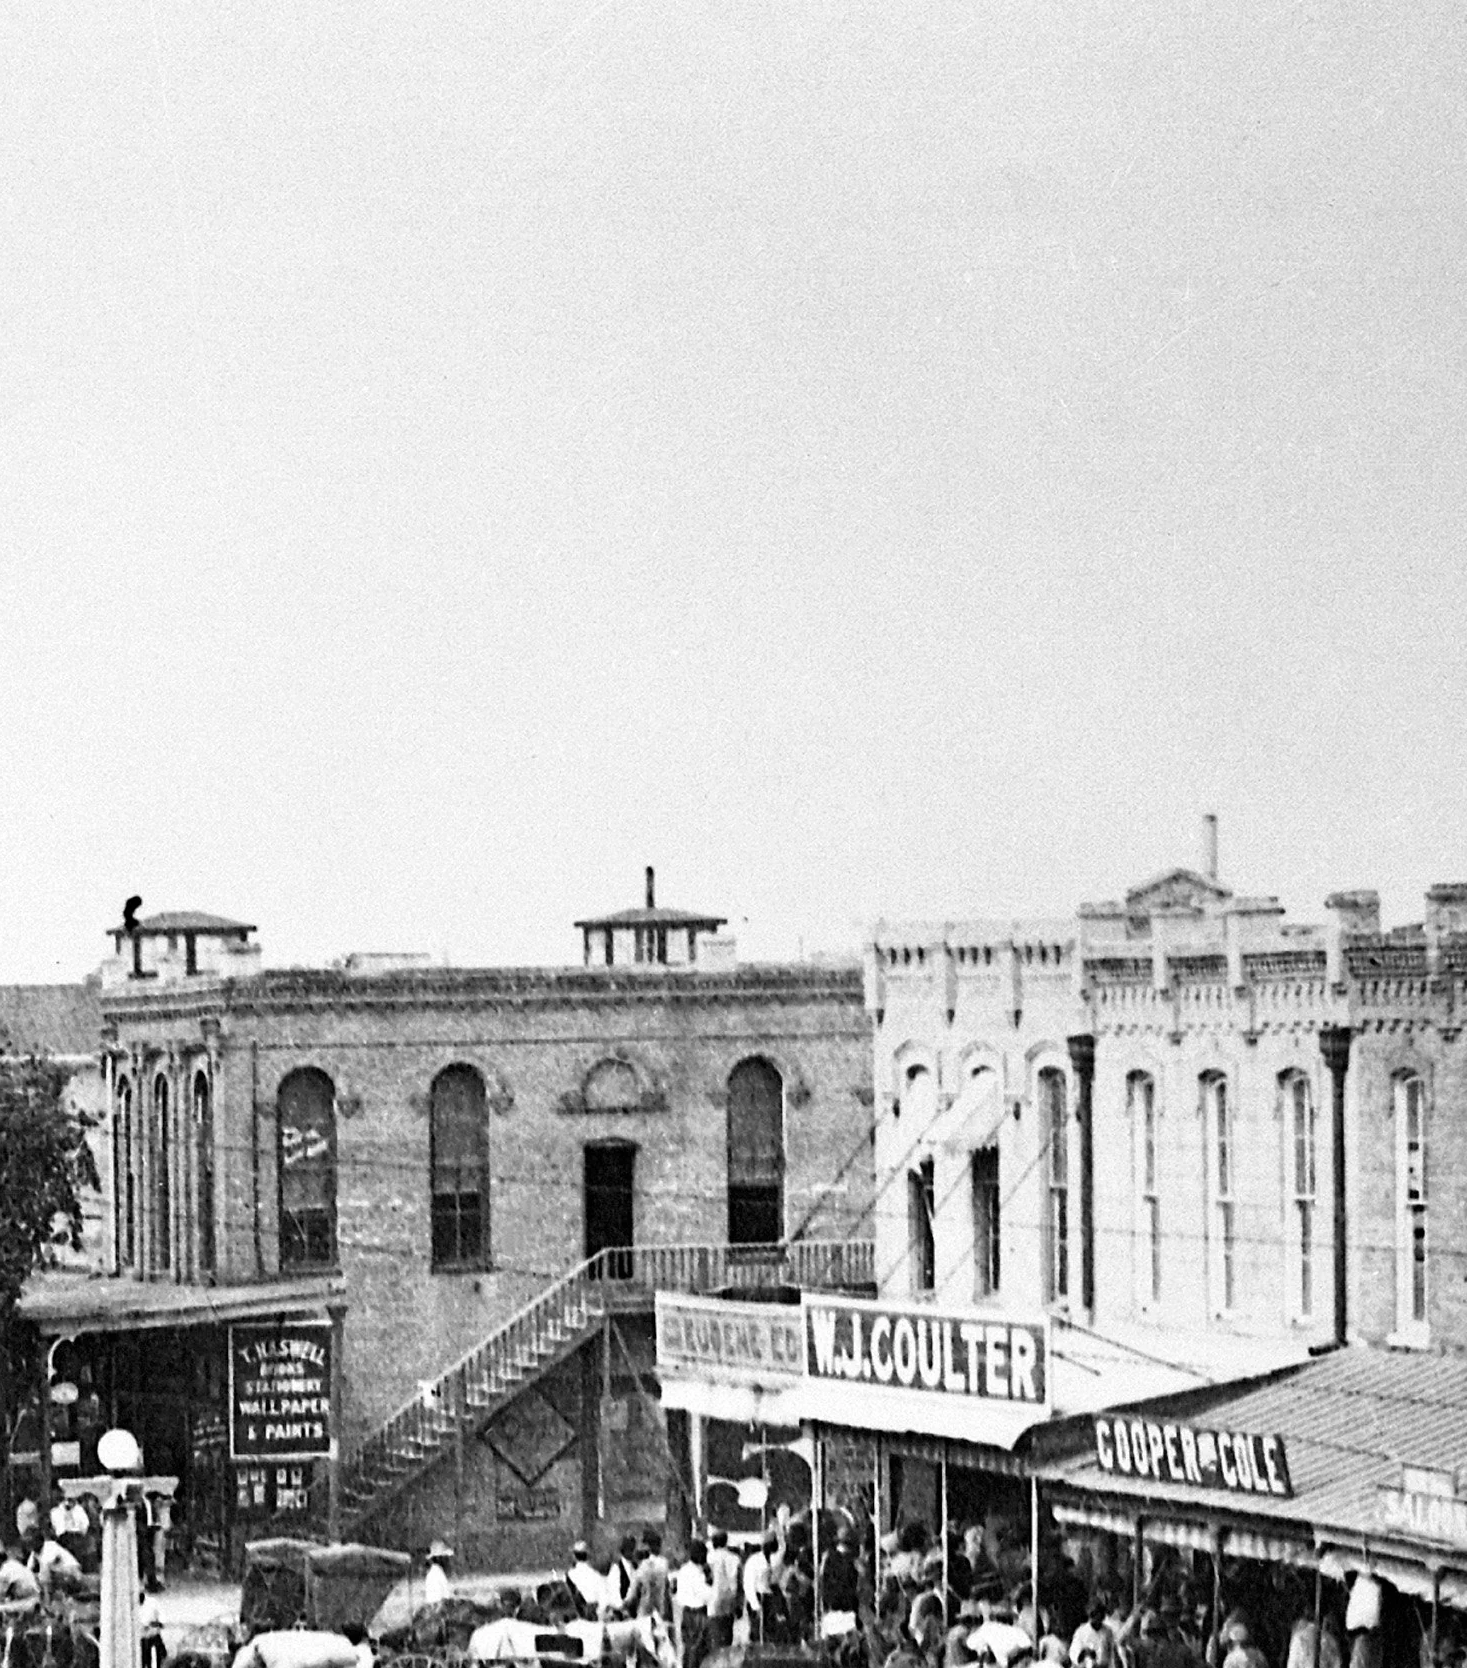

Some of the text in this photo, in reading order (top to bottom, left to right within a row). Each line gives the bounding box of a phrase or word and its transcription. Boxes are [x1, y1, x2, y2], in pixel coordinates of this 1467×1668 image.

[870, 1315, 1036, 1400] COULTER
[265, 1422, 323, 1441] PAINTS
[1096, 1419, 1202, 1484] COOPER
[1218, 1431, 1286, 1494] COLE
